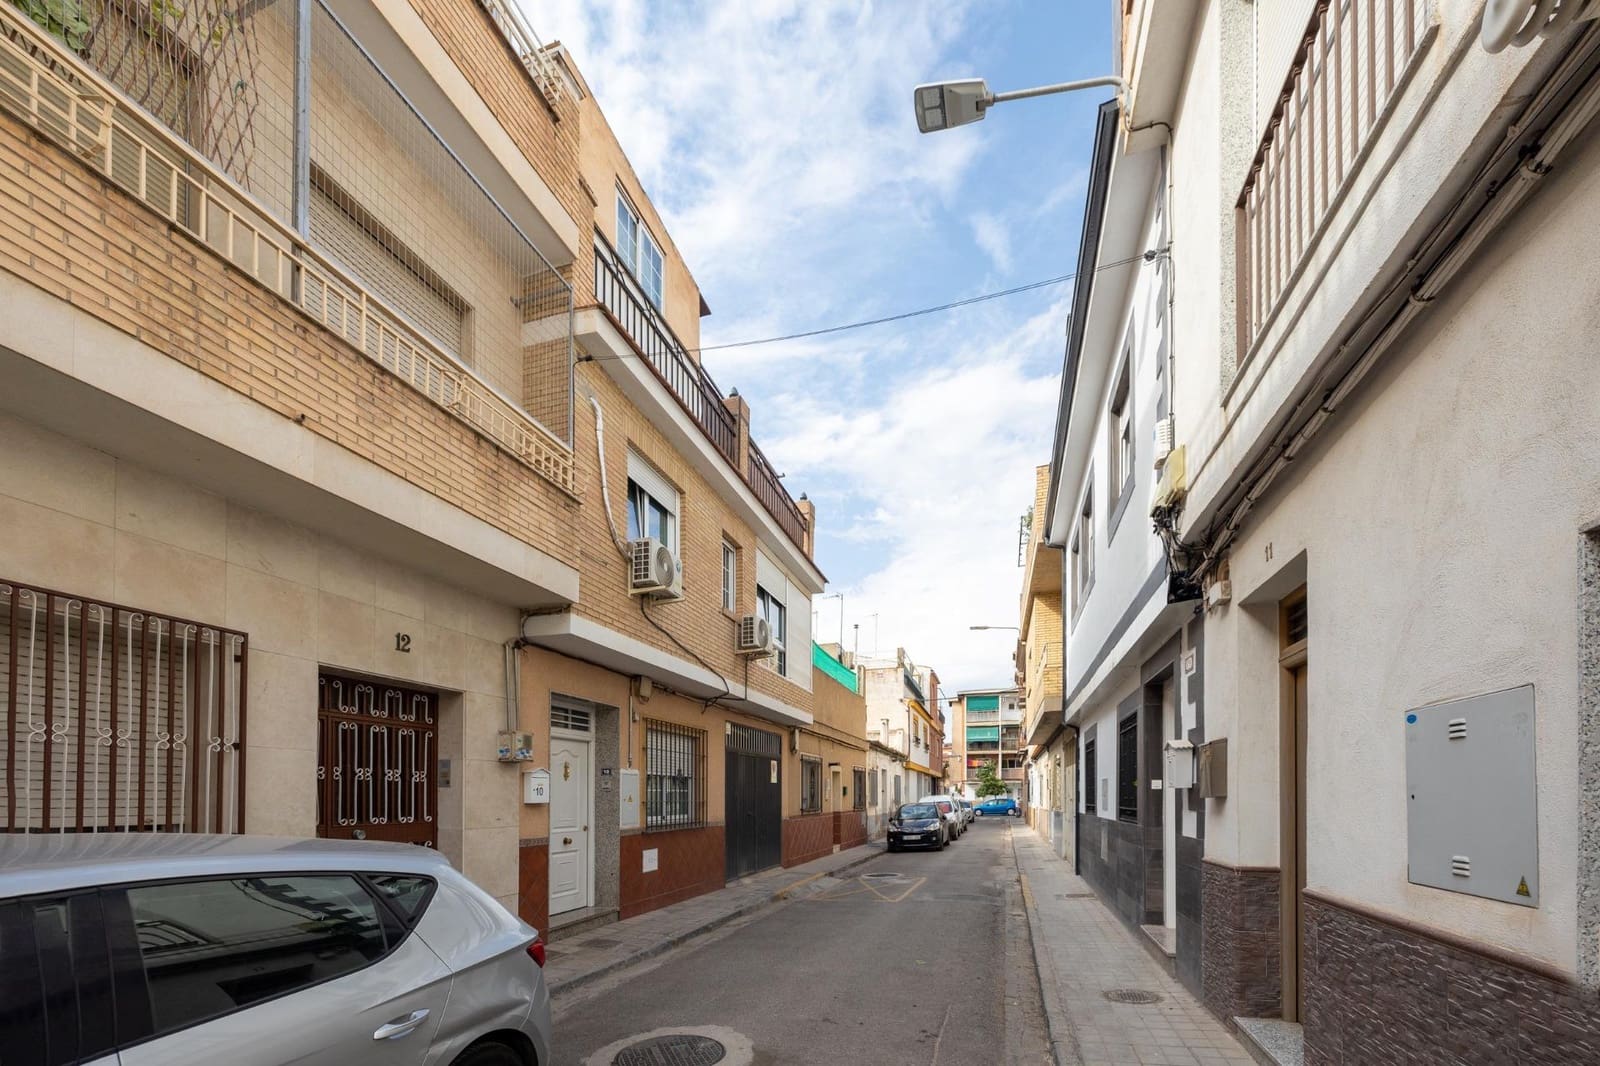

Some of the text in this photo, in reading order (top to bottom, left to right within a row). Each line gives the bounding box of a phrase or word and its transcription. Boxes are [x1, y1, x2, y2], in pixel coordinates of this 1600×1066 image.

[1264, 541, 1273, 562] 11
[395, 632, 411, 653] 12
[535, 786, 544, 796] 10
